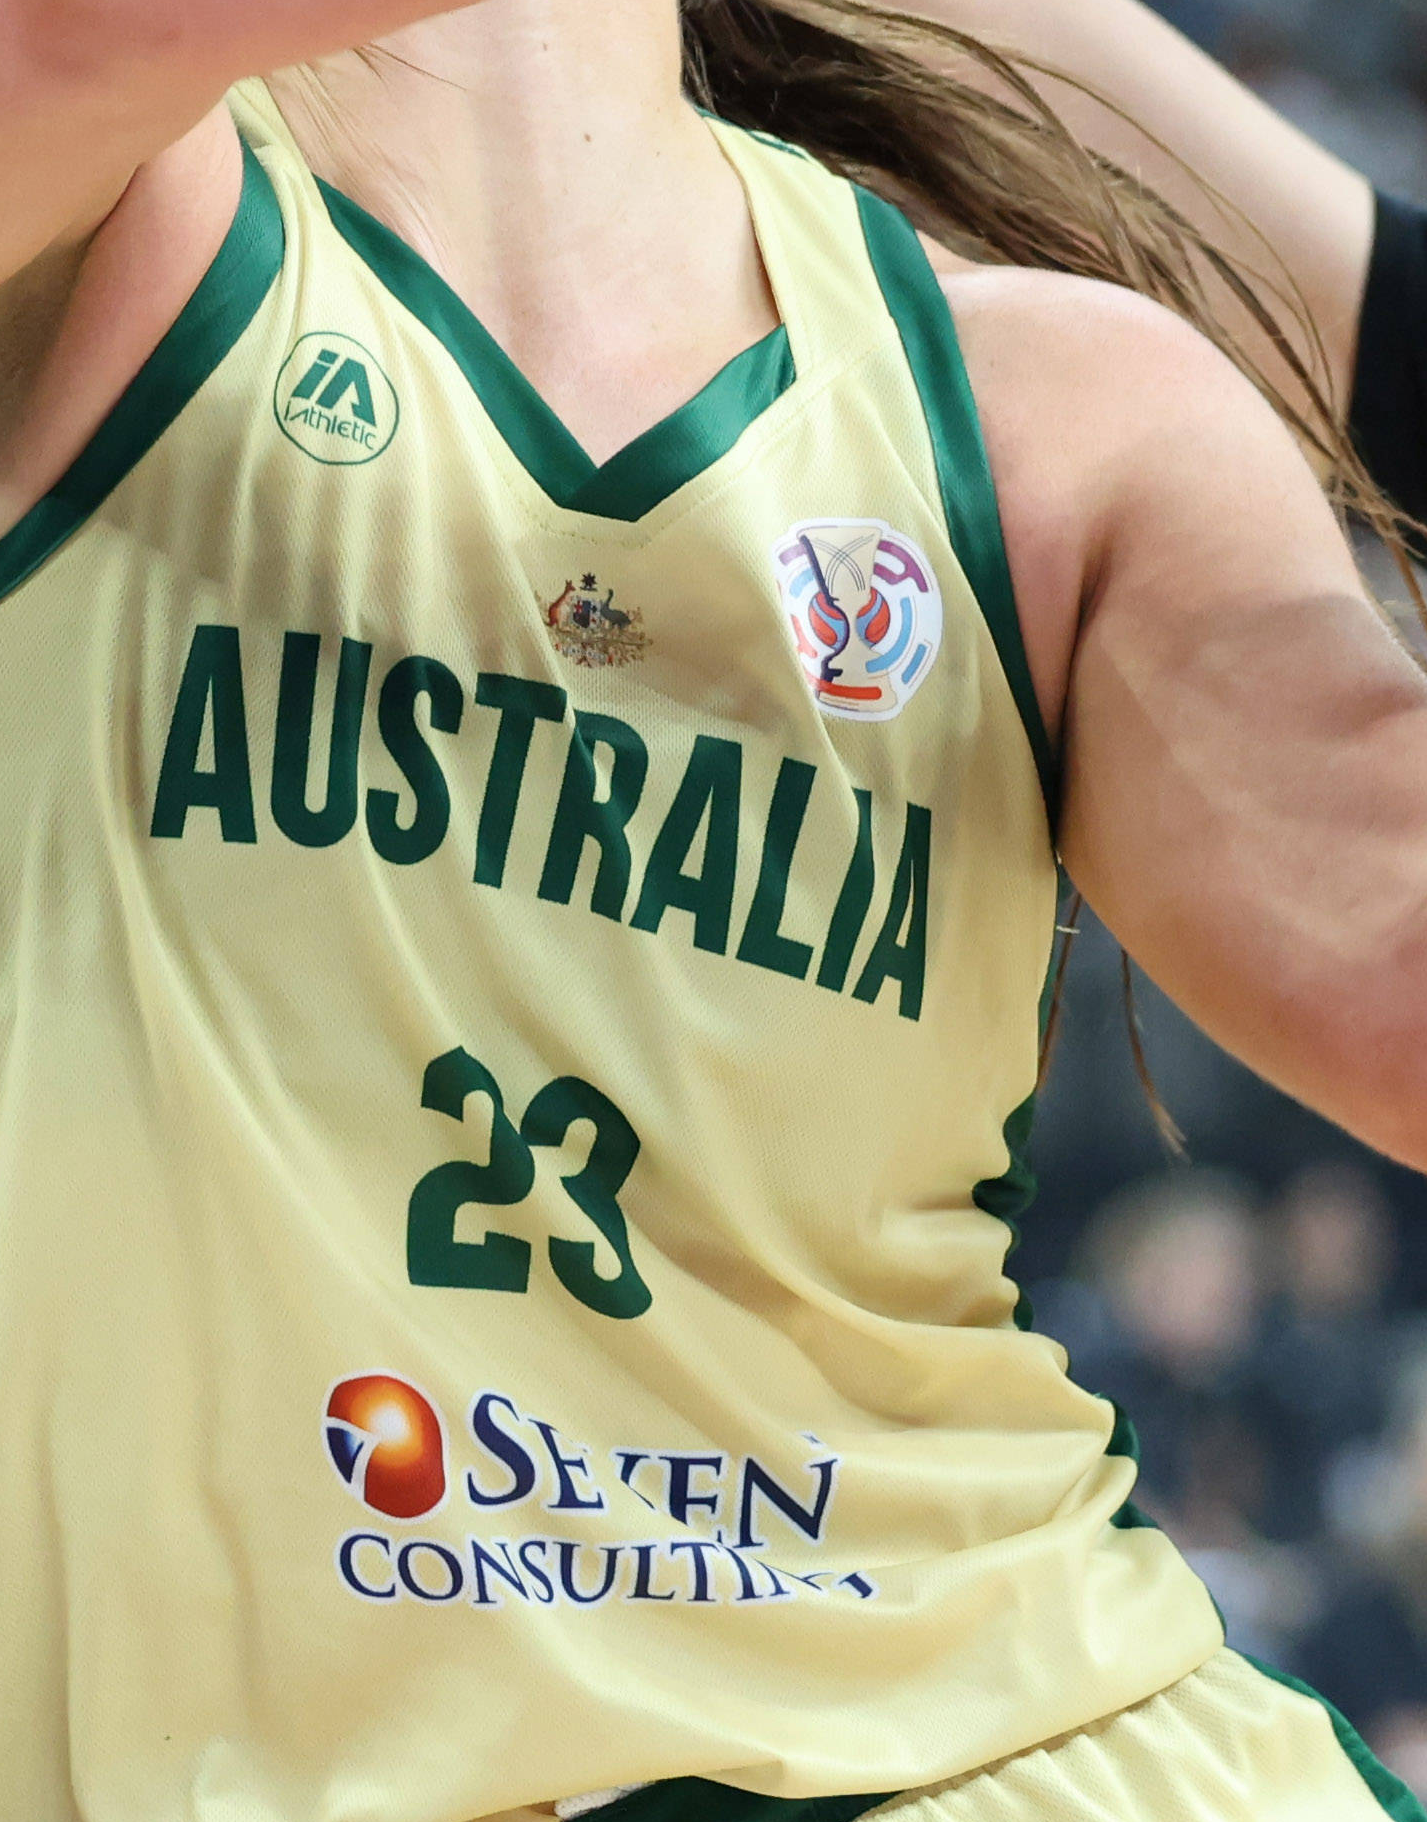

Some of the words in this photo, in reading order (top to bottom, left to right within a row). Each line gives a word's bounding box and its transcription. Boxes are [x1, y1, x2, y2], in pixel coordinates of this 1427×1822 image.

[149, 623, 934, 1024] AUSTRALIA
[406, 1045, 653, 1321] 23
[338, 1533, 874, 1604] CONSULTI
